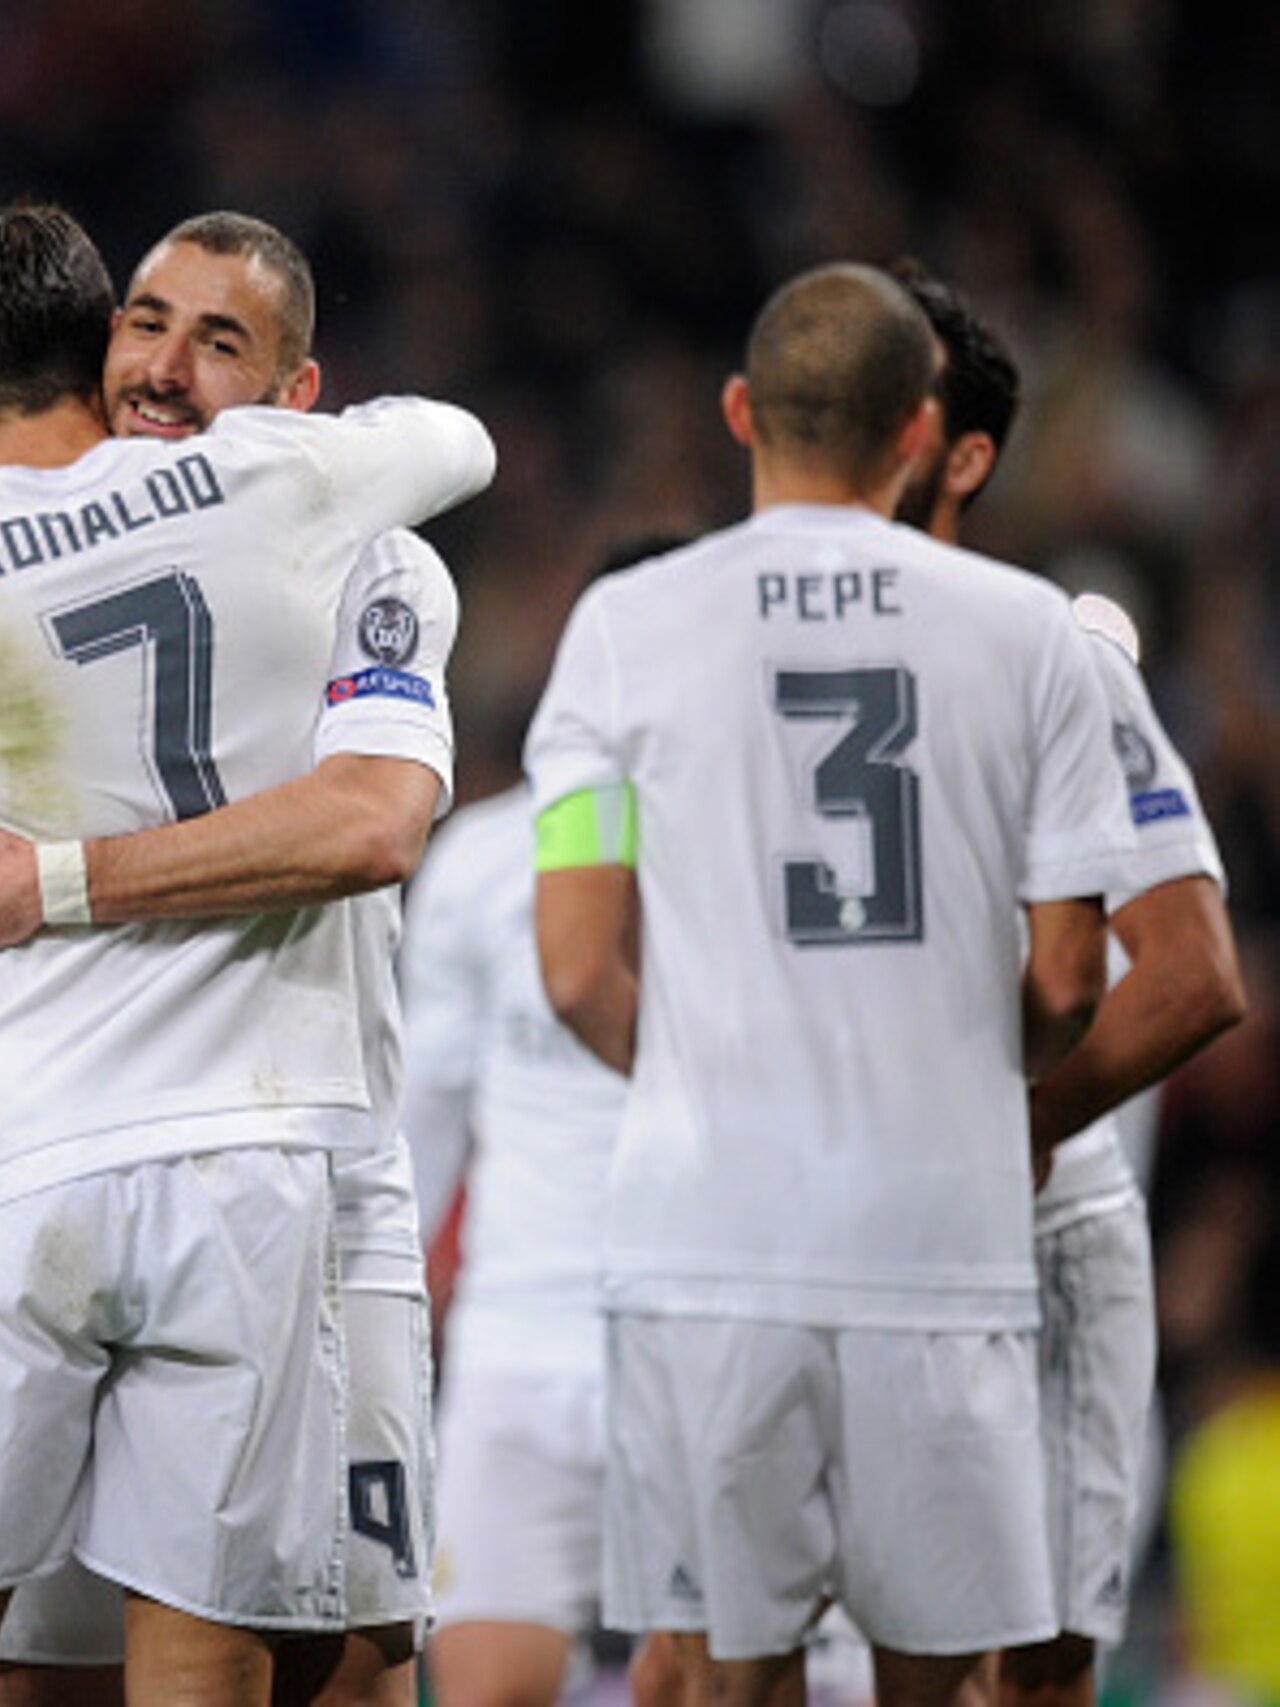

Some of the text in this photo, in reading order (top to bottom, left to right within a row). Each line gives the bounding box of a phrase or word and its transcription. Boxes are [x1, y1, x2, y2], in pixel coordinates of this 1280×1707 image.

[757, 568, 902, 621] PEPE
[40, 565, 228, 823] 7
[774, 665, 923, 948] 3
[348, 1460, 417, 1578] 9
